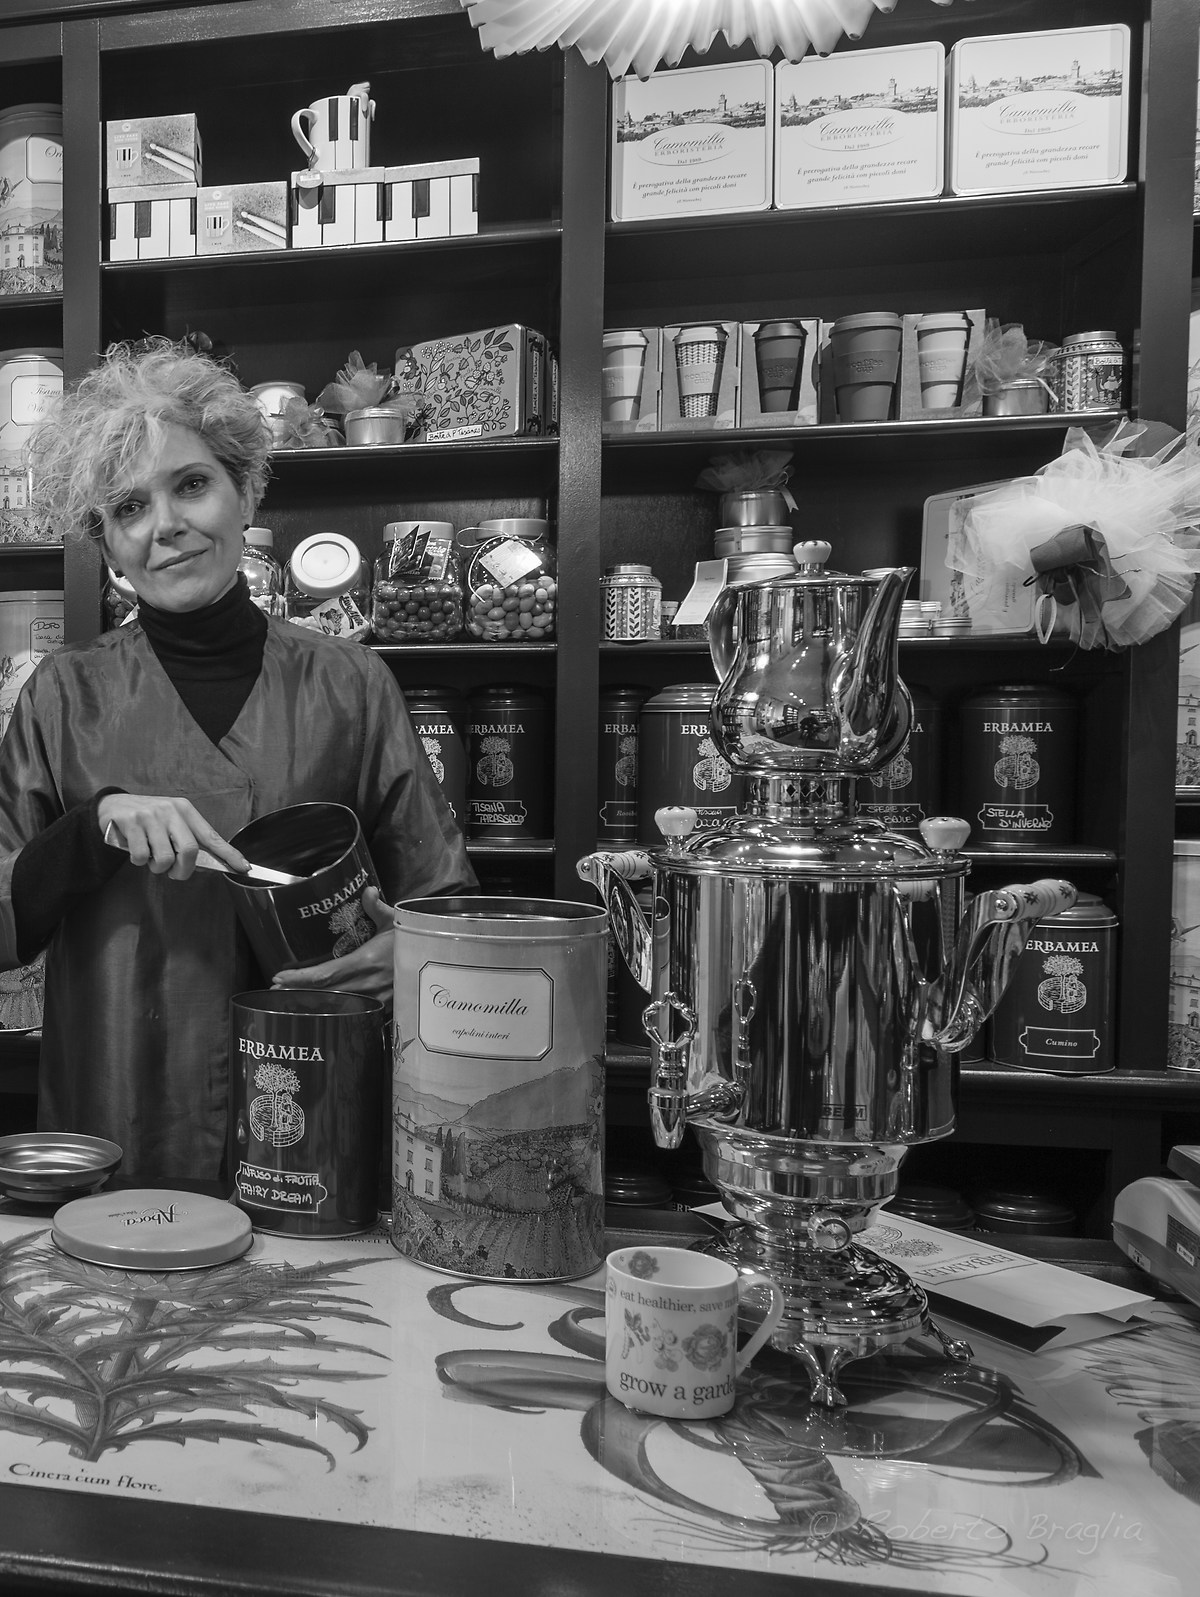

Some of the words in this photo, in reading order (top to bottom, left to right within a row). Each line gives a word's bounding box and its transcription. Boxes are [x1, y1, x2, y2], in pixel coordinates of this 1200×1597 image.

[1000, 99, 1076, 116] Camomilla
[820, 116, 894, 134] Camomilla
[654, 131, 725, 150] Camomilla
[821, 130, 892, 141] ERBORISTERIA
[655, 145, 723, 156] ERBORISTERIA
[804, 166, 840, 176] prerogativa
[860, 161, 895, 170] grandezza
[639, 181, 674, 190] prerogativa
[692, 175, 726, 183] grandezza
[807, 176, 830, 184] grande
[869, 170, 890, 178] piccoli
[642, 190, 664, 198] grande
[701, 183, 720, 192] piccoli
[983, 722, 1053, 734] ERBAMEA
[987, 808, 1025, 818] STELLA
[999, 819, 1051, 828] D'INVERNO
[298, 867, 368, 918] ERBAMEA
[1026, 940, 1099, 953] ERBAMEA
[429, 984, 528, 1015] Camomilla
[452, 1029, 484, 1039] capolini
[239, 1038, 324, 1061] ERBAMEA
[1046, 1038, 1077, 1047] Cumino
[241, 1166, 272, 1181] INFUSO
[241, 1182, 269, 1198] FAIRY
[271, 1189, 312, 1204] DREAM
[123, 1204, 180, 1226] Aboca
[915, 1254, 1015, 1277] ERBAMEA
[621, 1290, 635, 1302] eat
[638, 1292, 696, 1312] healthier,
[700, 1302, 721, 1312] save
[620, 1372, 667, 1398] grow
[674, 1385, 686, 1400] a
[9, 1463, 70, 1481] Cinera
[75, 1475, 110, 1486] cum
